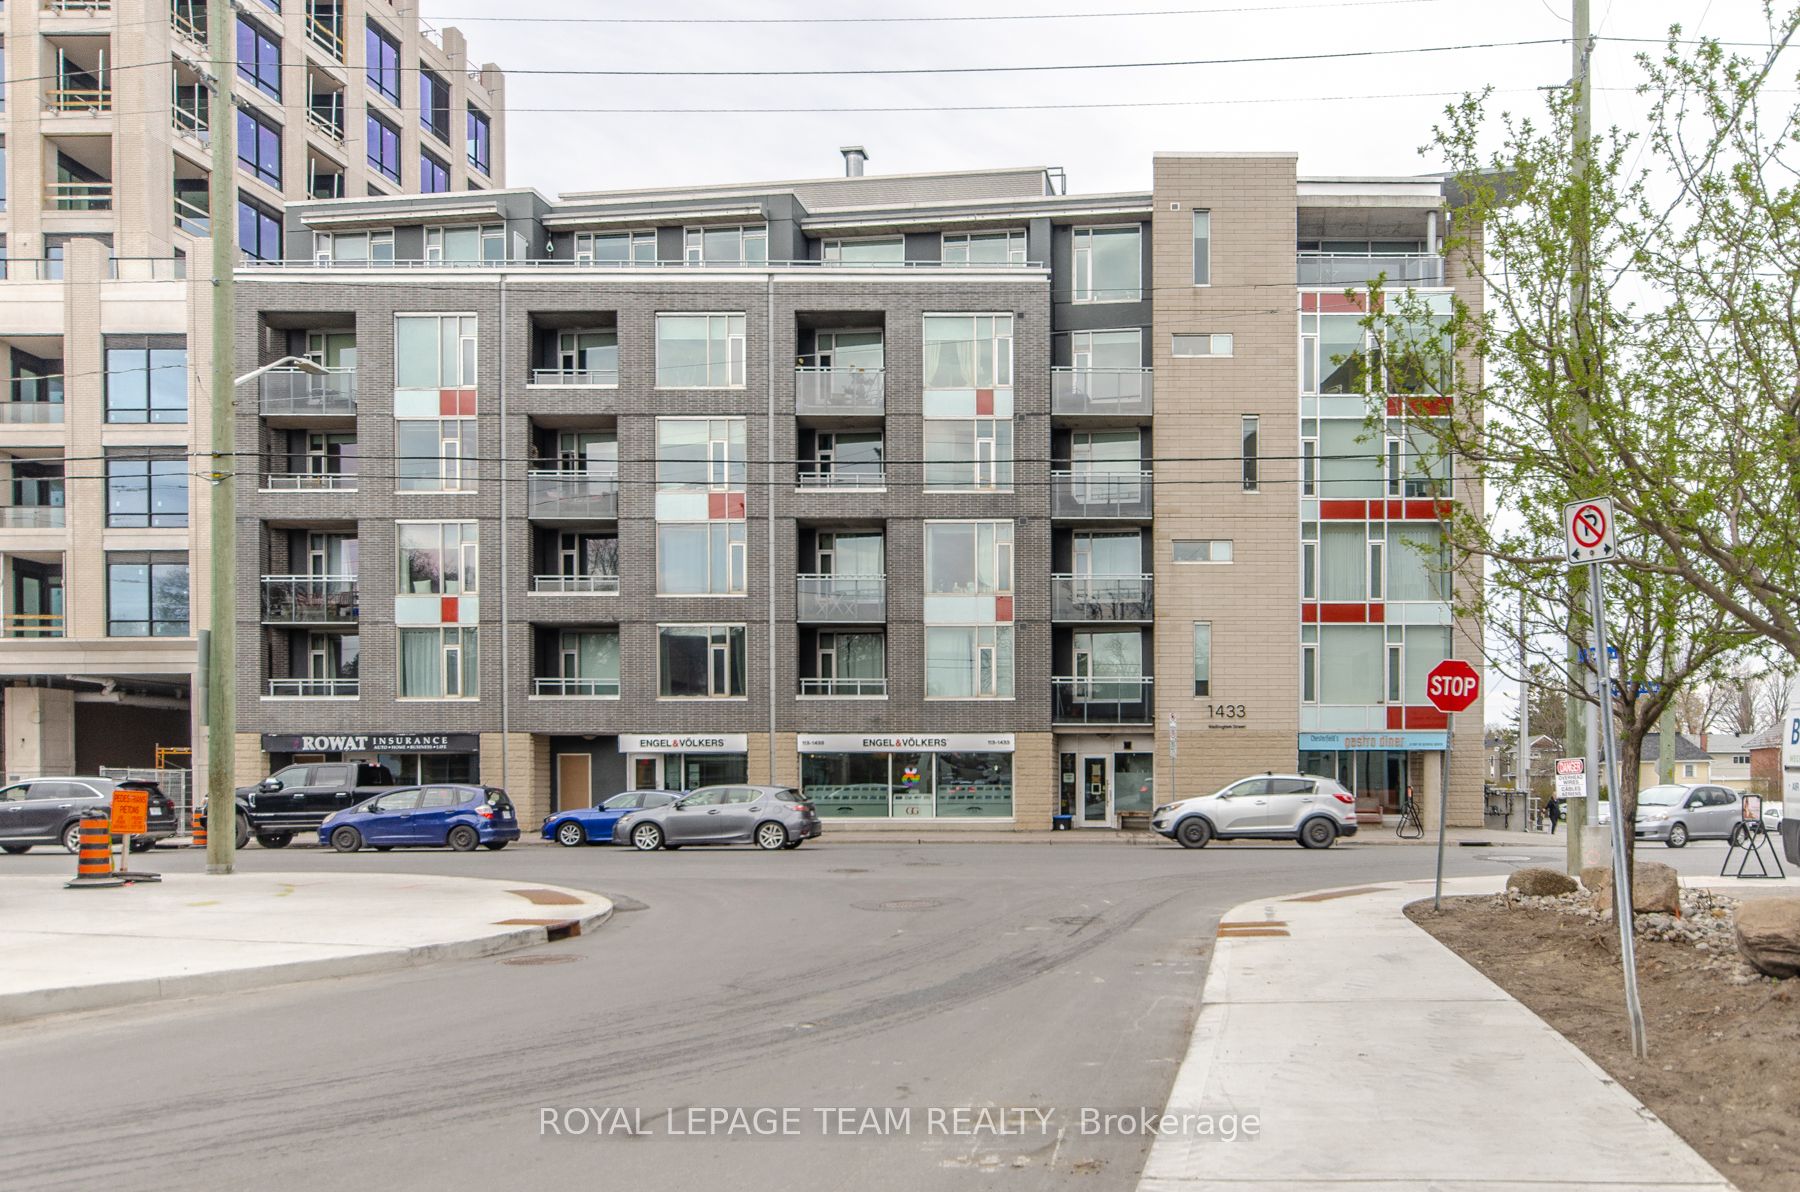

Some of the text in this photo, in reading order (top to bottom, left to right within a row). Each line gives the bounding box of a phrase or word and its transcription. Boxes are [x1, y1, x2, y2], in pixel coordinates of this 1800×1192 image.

[1430, 675, 1476, 697] STOP
[1208, 704, 1246, 718] 1433
[302, 736, 448, 751] ROWAT INSURANCE
